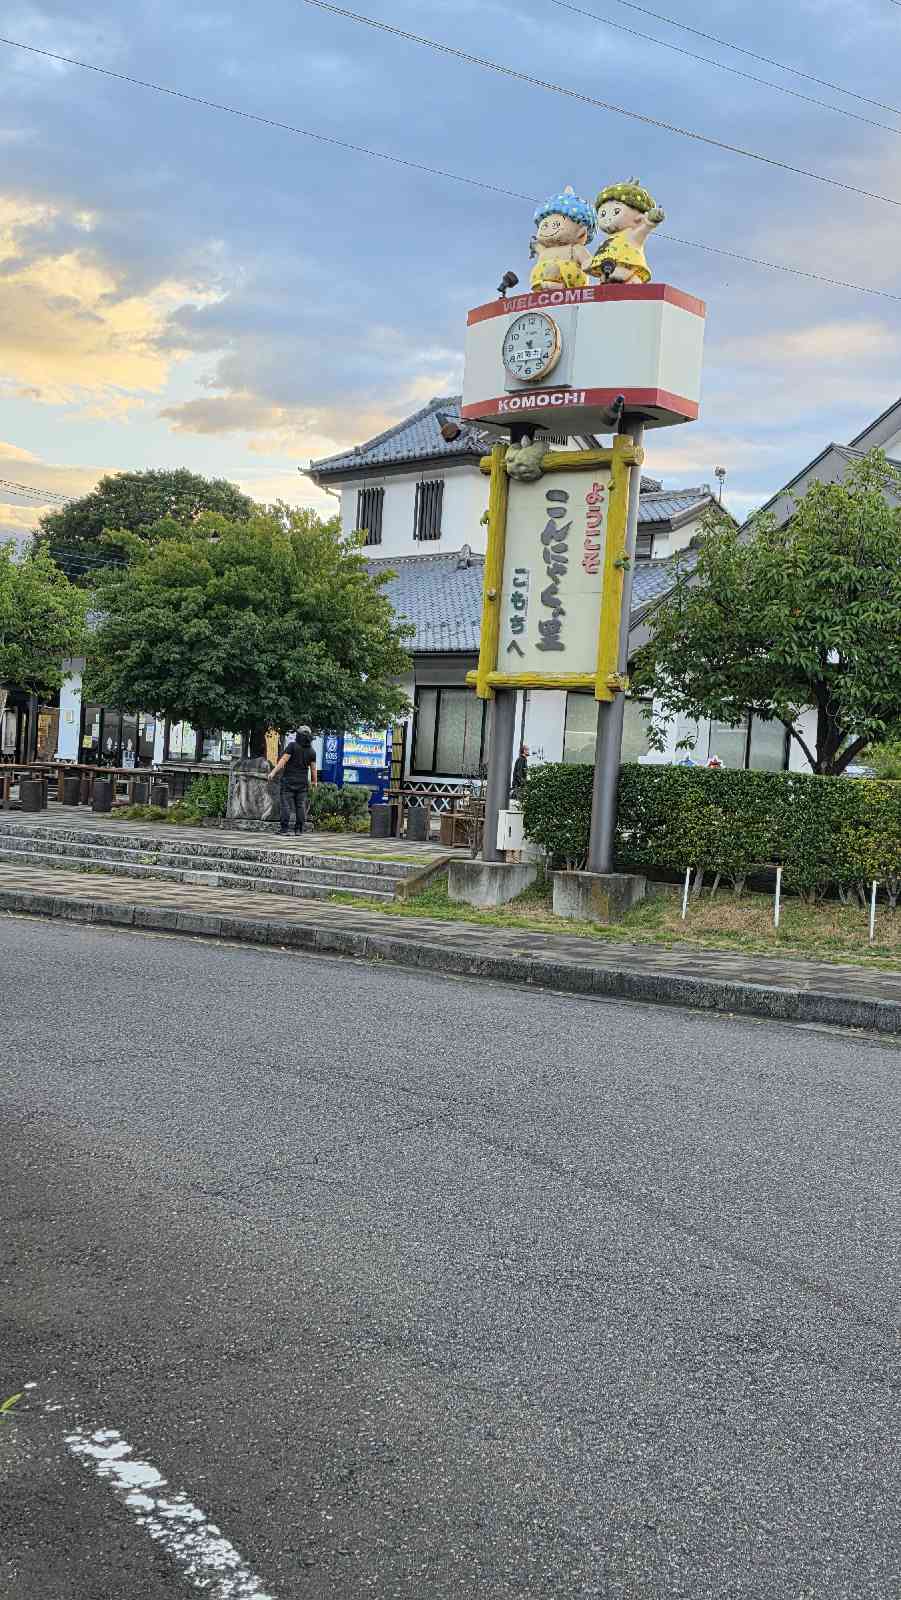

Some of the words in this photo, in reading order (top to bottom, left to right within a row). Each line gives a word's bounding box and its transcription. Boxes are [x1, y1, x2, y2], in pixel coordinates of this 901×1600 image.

[502, 288, 595, 311] WELCOME
[498, 392, 586, 412] KOMOCHI
[582, 482, 605, 575] ようこそ
[506, 567, 530, 658] こもちへ
